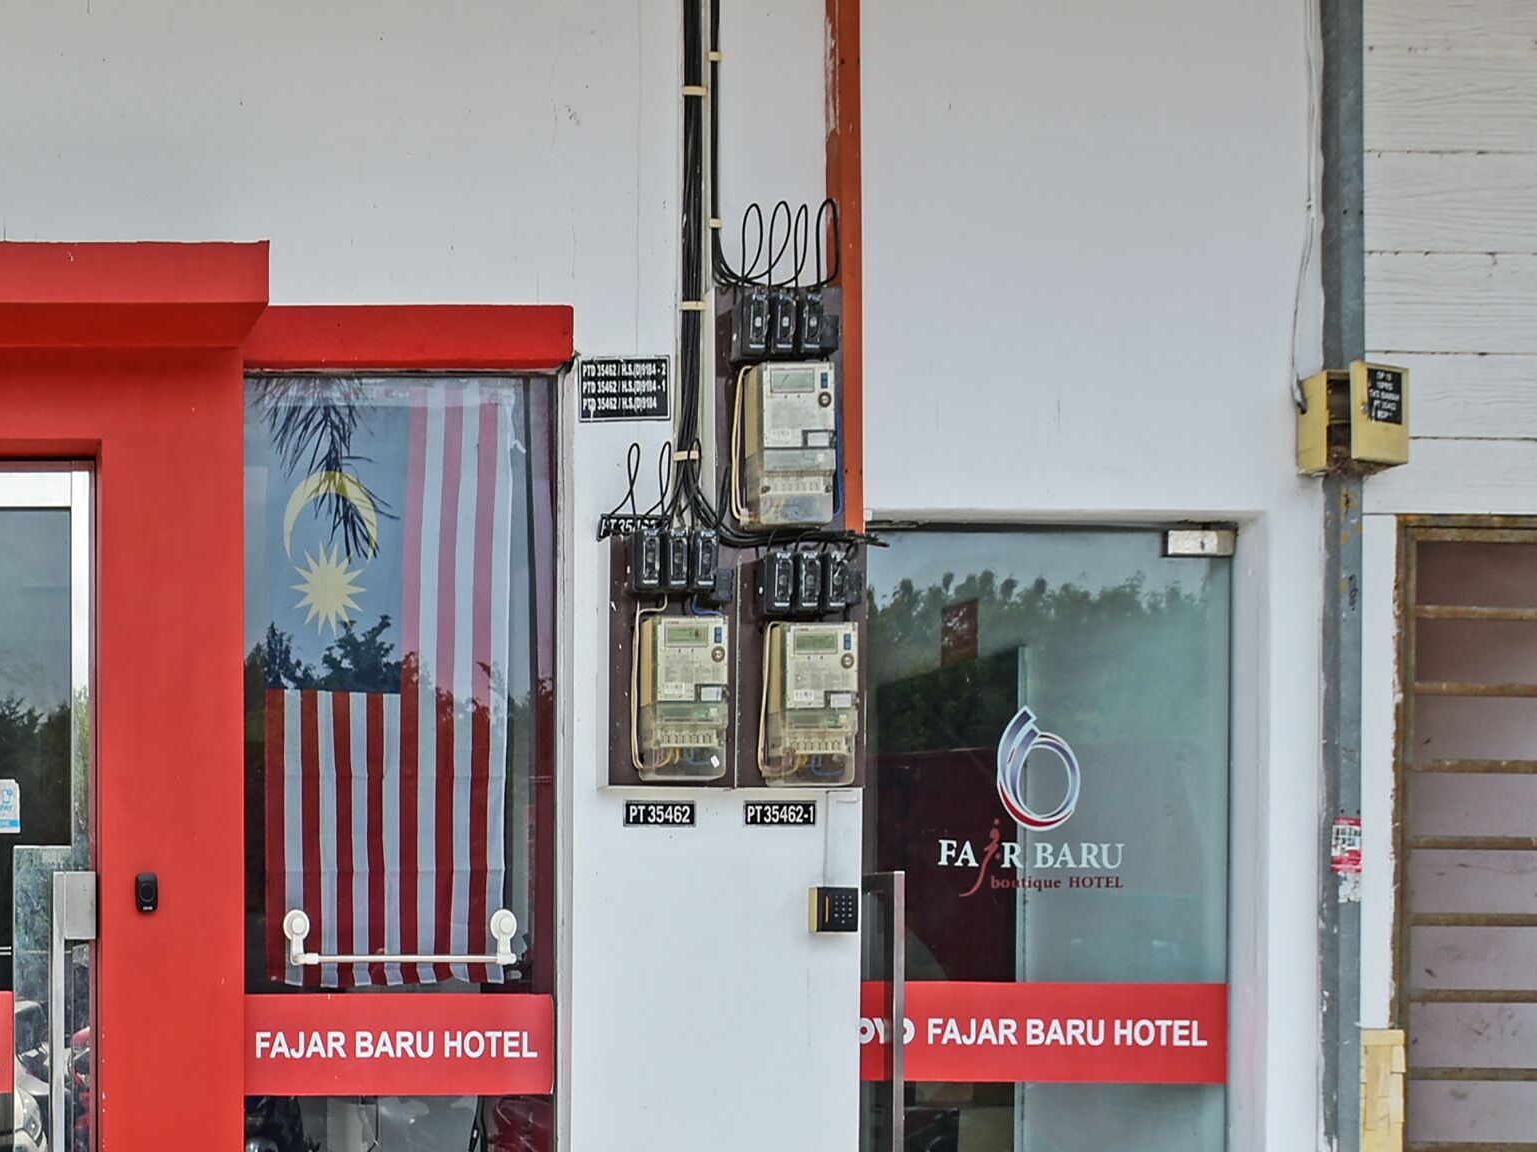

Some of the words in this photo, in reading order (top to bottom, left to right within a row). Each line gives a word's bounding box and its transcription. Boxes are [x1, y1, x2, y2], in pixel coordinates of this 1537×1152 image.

[583, 364, 596, 377] PTD
[583, 381, 596, 394] PTD
[1034, 842, 1125, 870] BARU
[990, 875, 1062, 892] boutique
[1068, 876, 1123, 889] HOTEL
[927, 1018, 1018, 1045] FAJAR
[1026, 1019, 1105, 1046] BARU
[1114, 1019, 1208, 1047] HOTEL
[255, 1031, 347, 1059] FAJAR
[355, 1030, 434, 1059] BARU
[444, 1030, 538, 1058] HOTEL
